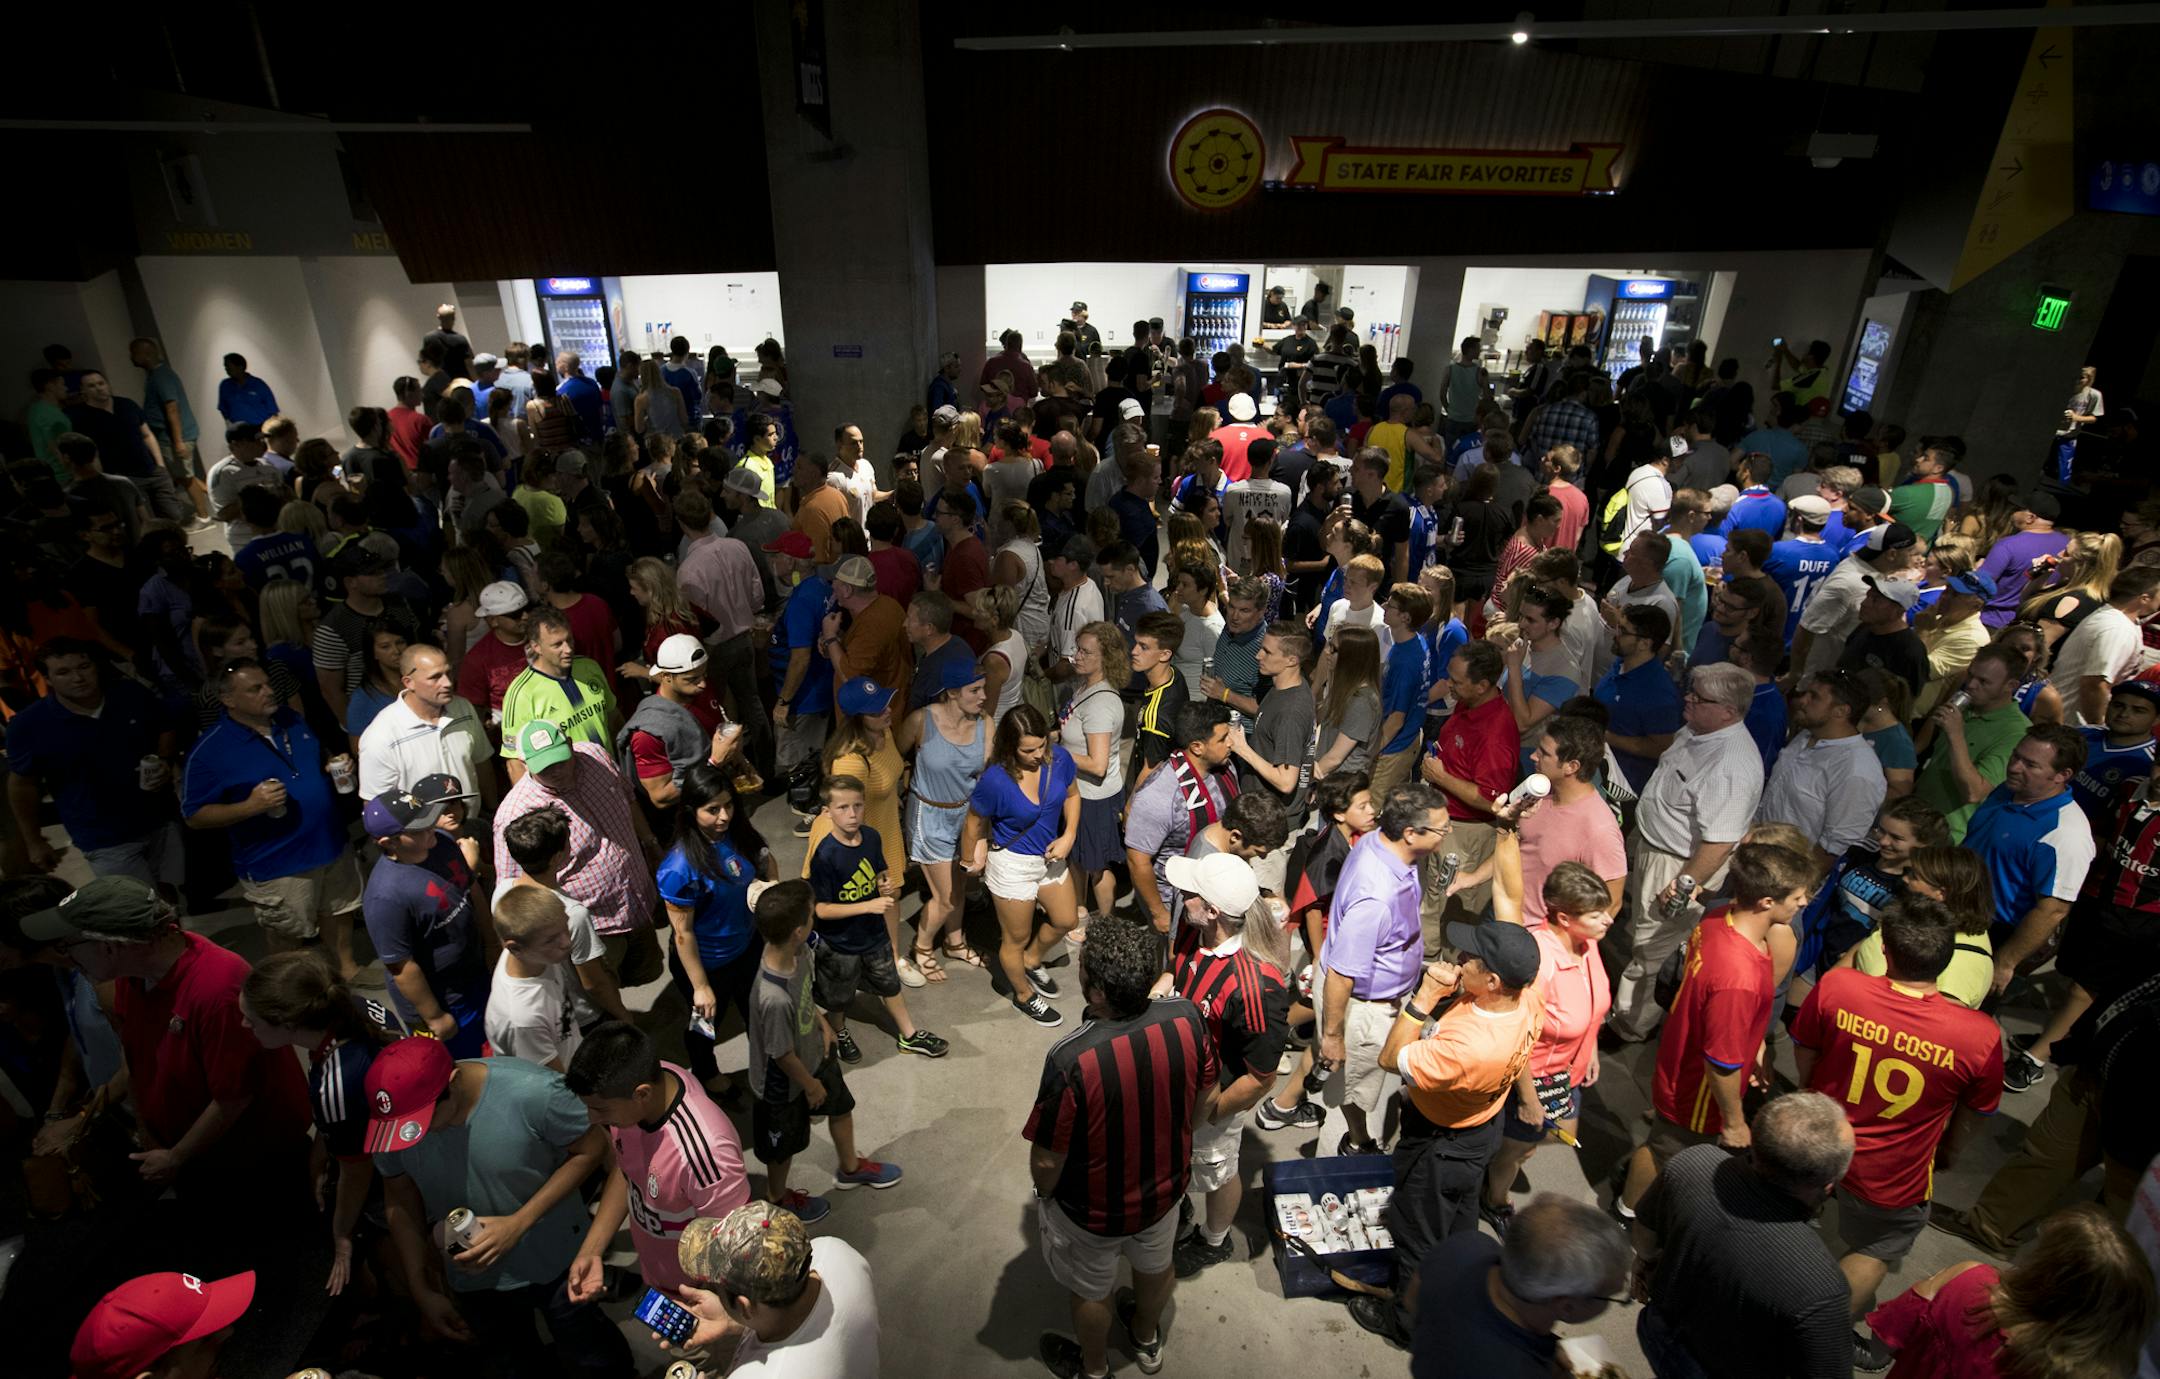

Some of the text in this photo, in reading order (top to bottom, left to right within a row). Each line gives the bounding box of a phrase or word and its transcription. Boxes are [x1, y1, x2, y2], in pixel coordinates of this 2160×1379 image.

[1336, 162, 1574, 184] STATE FAIR FAVORITES
[165, 231, 252, 250] WOMEN
[2037, 297, 2068, 329] EXIT
[256, 540, 305, 562] WILLIAN
[1799, 559, 1831, 573] DUFF
[2076, 768, 2110, 798] SUNG
[1836, 1007, 1955, 1071] DIEGO COSTA
[1846, 1041, 1926, 1120] 19
